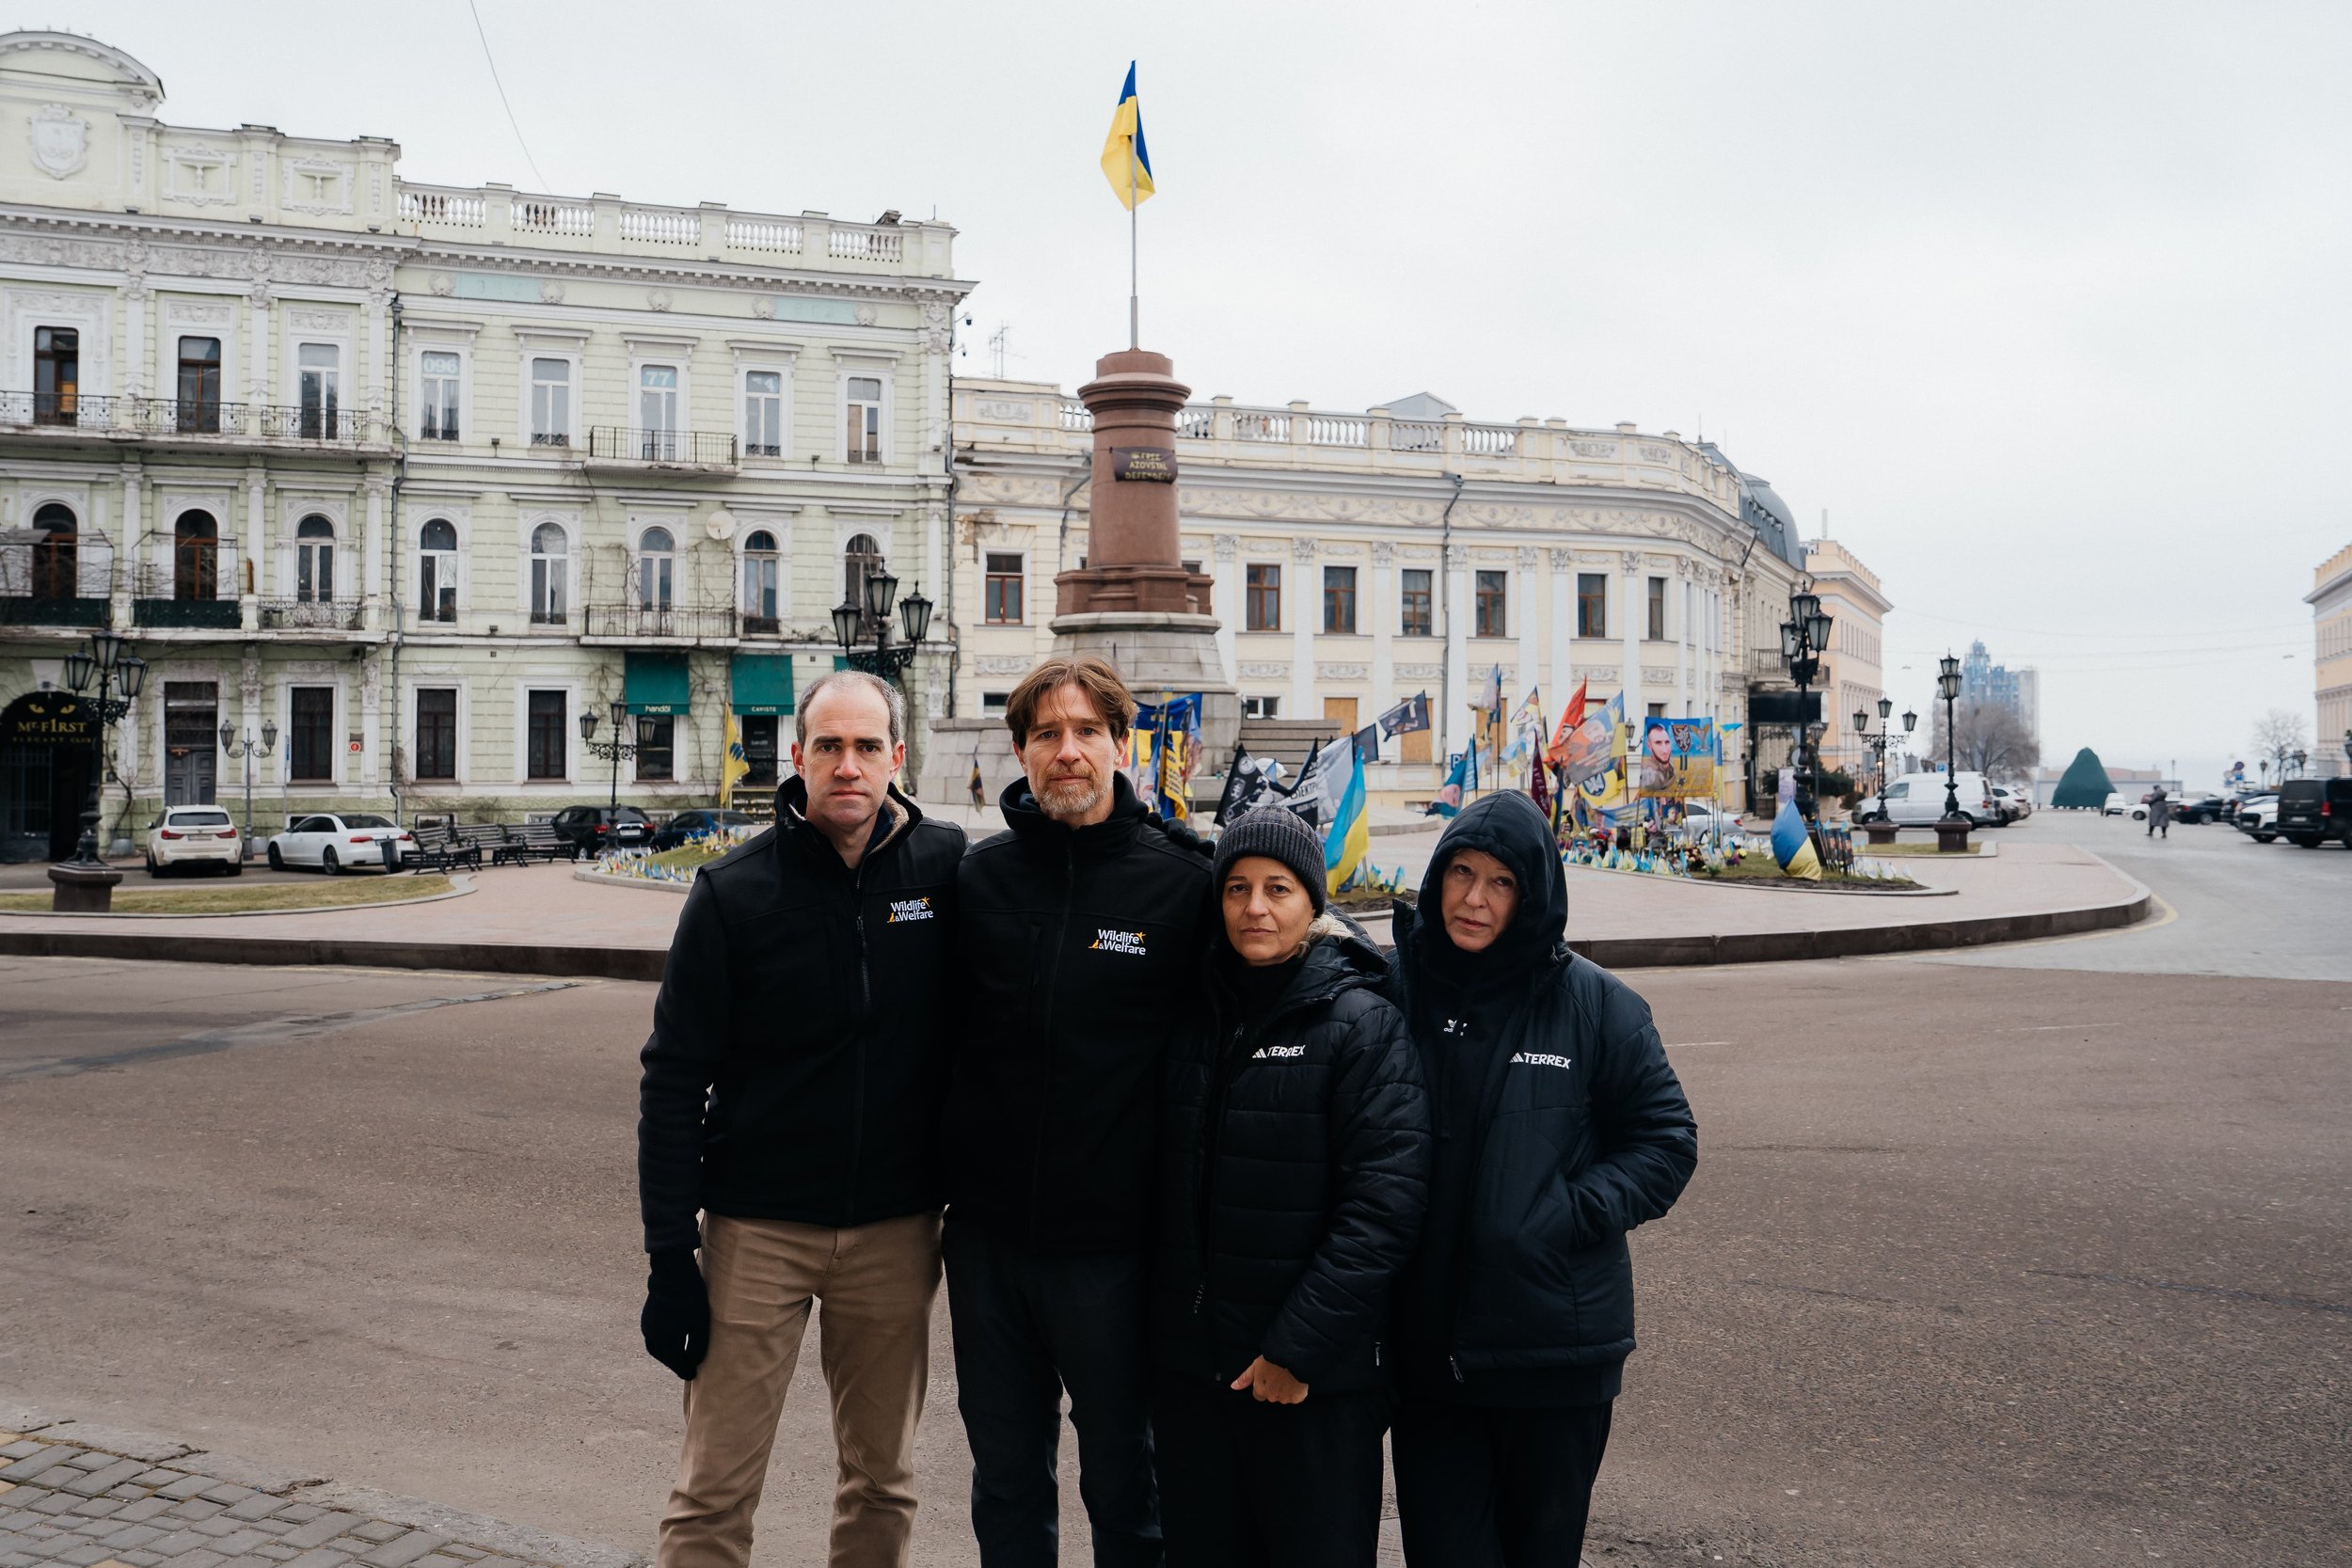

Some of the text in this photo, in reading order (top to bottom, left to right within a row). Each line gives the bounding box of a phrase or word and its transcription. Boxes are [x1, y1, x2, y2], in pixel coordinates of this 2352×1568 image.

[423, 357, 458, 374] 096
[1141, 452, 1161, 461] FREE
[1129, 461, 1168, 470] AZOVSTAL
[1452, 754, 1461, 768] P
[890, 899, 927, 912] Wildlife
[895, 910, 933, 922] &Welfare
[1098, 928, 1140, 944] Wildlife
[1099, 940, 1147, 956] &Welfare
[1267, 1044, 1306, 1058] TERREX
[1524, 1052, 1571, 1069] TERREX
